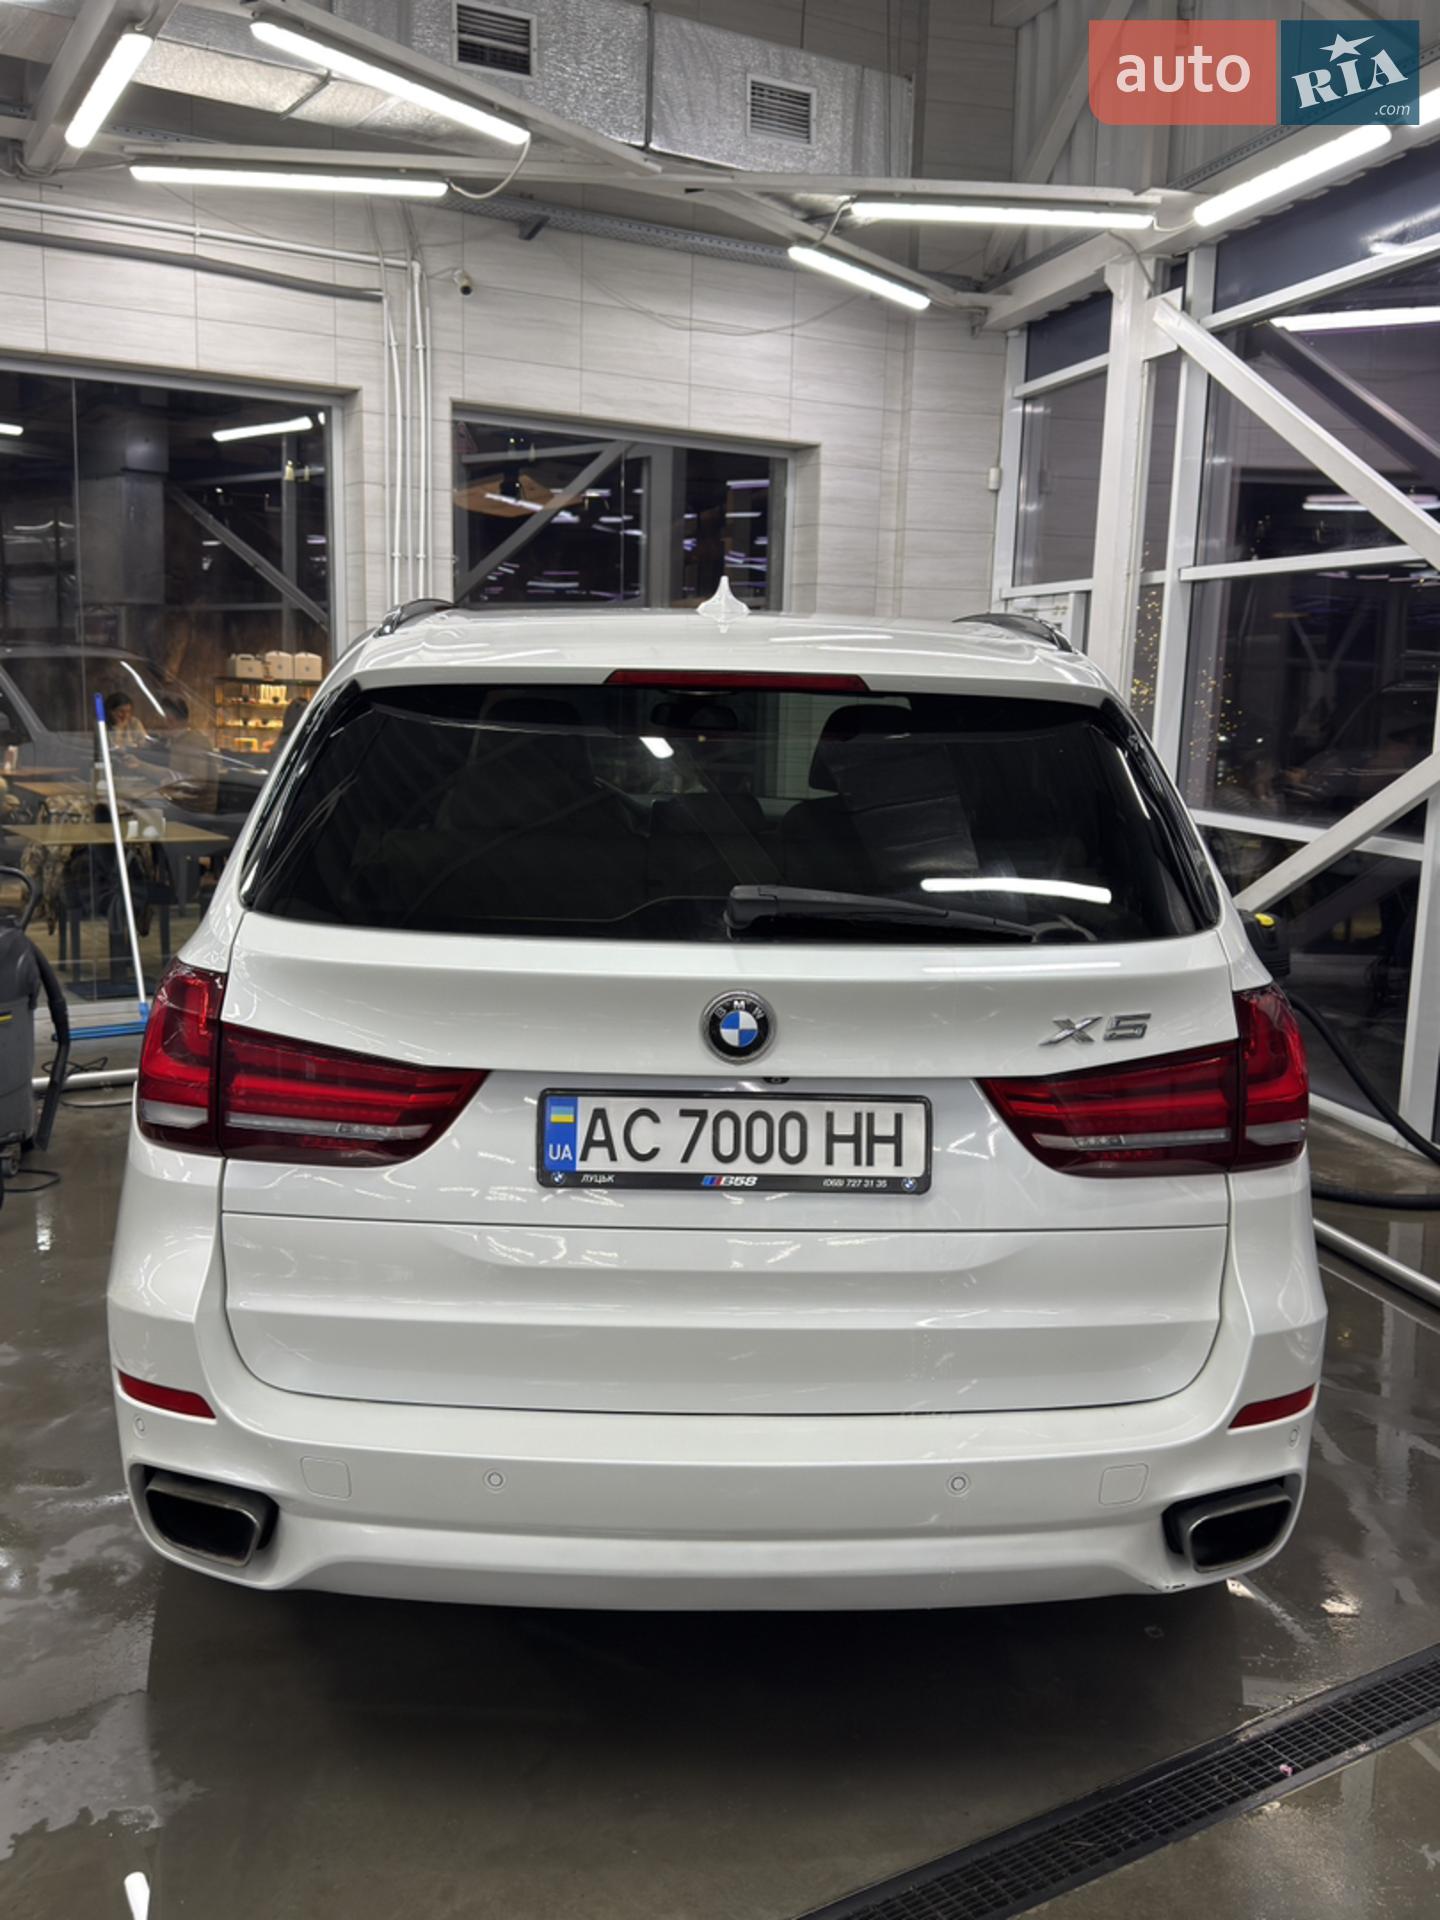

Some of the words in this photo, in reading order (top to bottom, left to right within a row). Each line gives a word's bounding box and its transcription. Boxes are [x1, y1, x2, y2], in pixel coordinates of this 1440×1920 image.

[1038, 1012, 1152, 1046] X5
[579, 1107, 662, 1163] AC
[678, 1108, 808, 1166] 7000
[824, 1110, 904, 1168] HH
[548, 1144, 574, 1161] UA
[846, 1178, 863, 1189] 727
